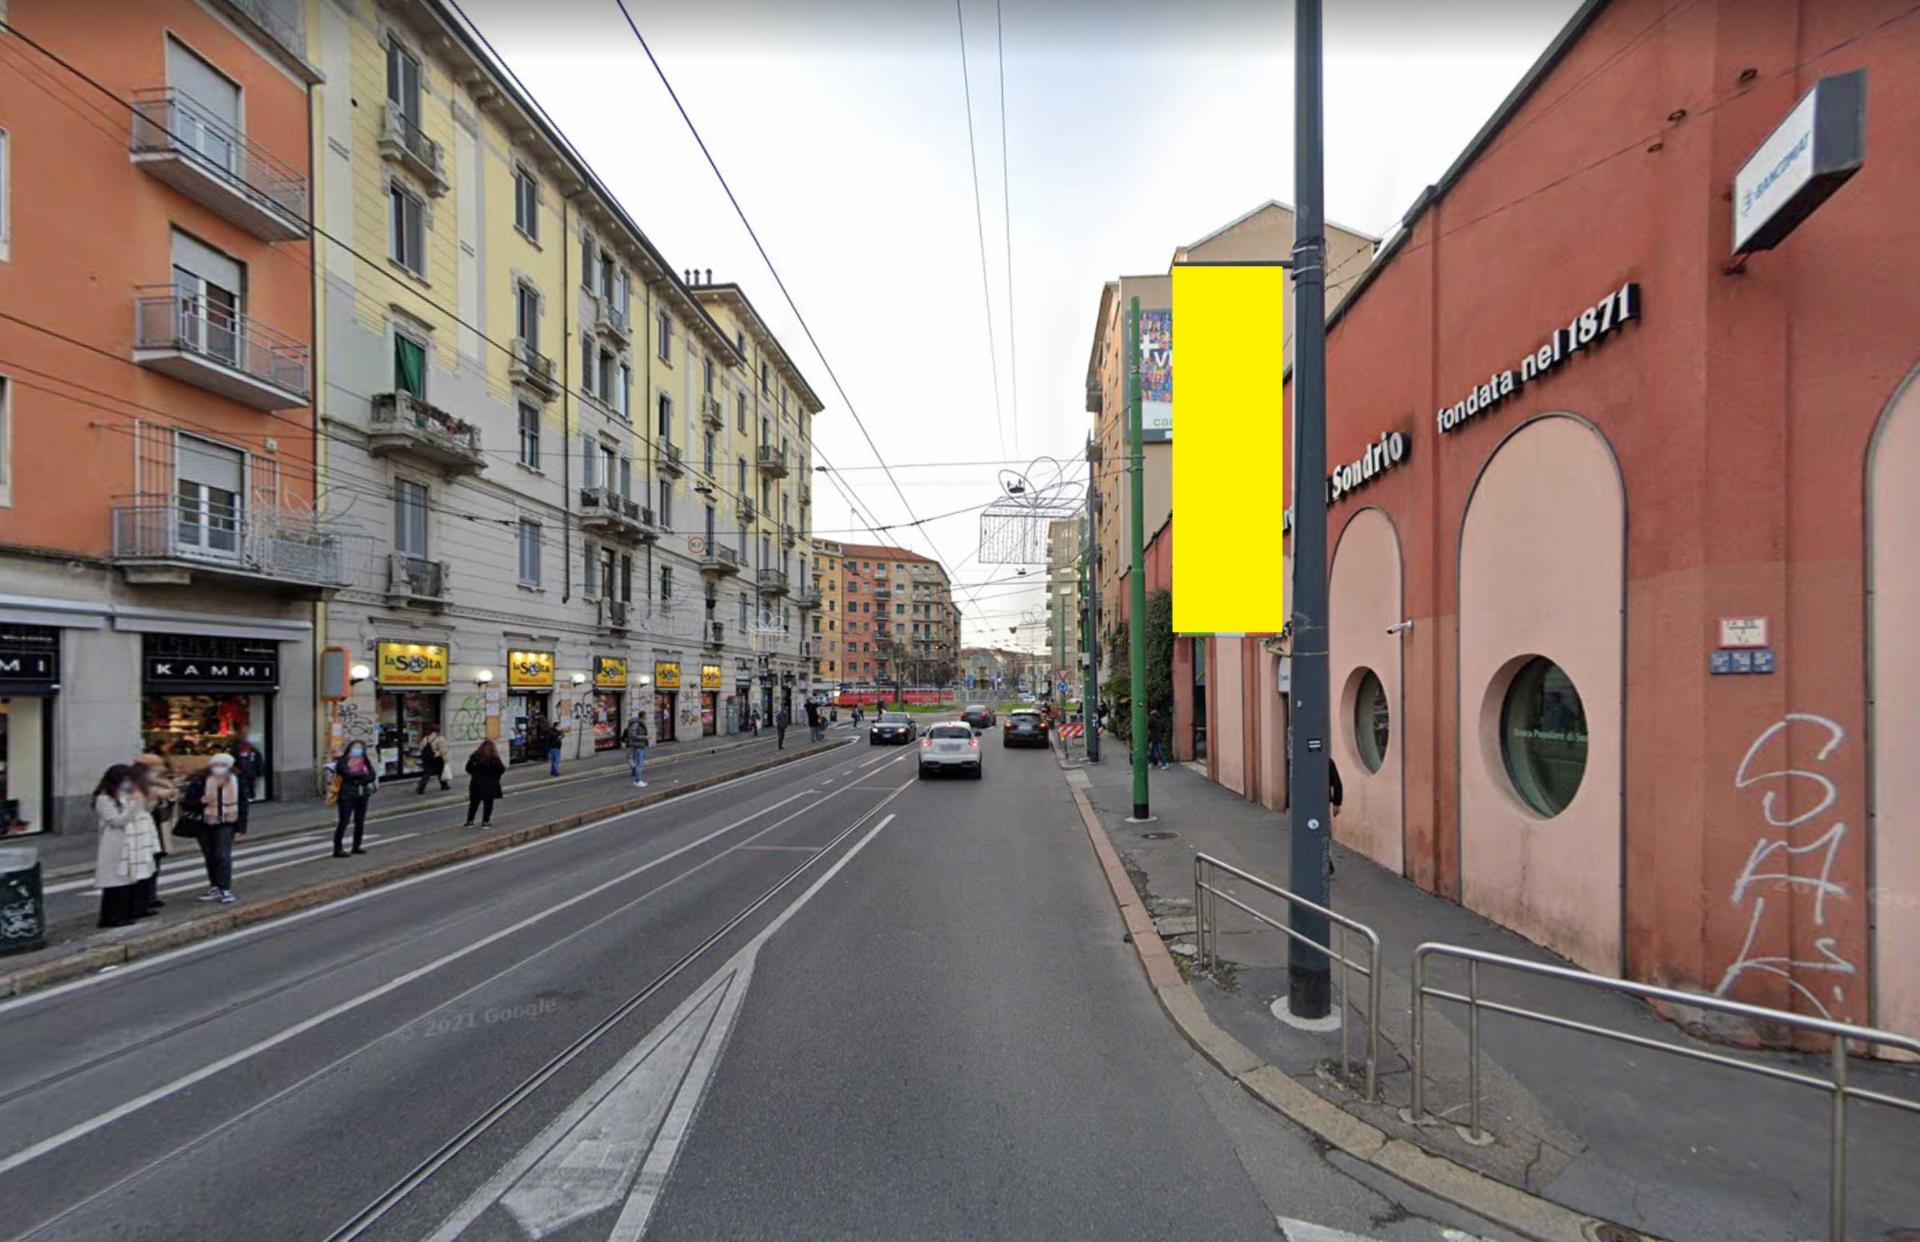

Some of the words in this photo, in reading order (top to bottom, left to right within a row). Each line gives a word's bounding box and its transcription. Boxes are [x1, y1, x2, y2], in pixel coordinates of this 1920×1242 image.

[1437, 368, 1515, 434] fondata
[1521, 329, 1561, 382] nel
[1567, 283, 1631, 353] 1871
[1332, 431, 1404, 500] Sondrio
[156, 664, 270, 677] KAMMI
